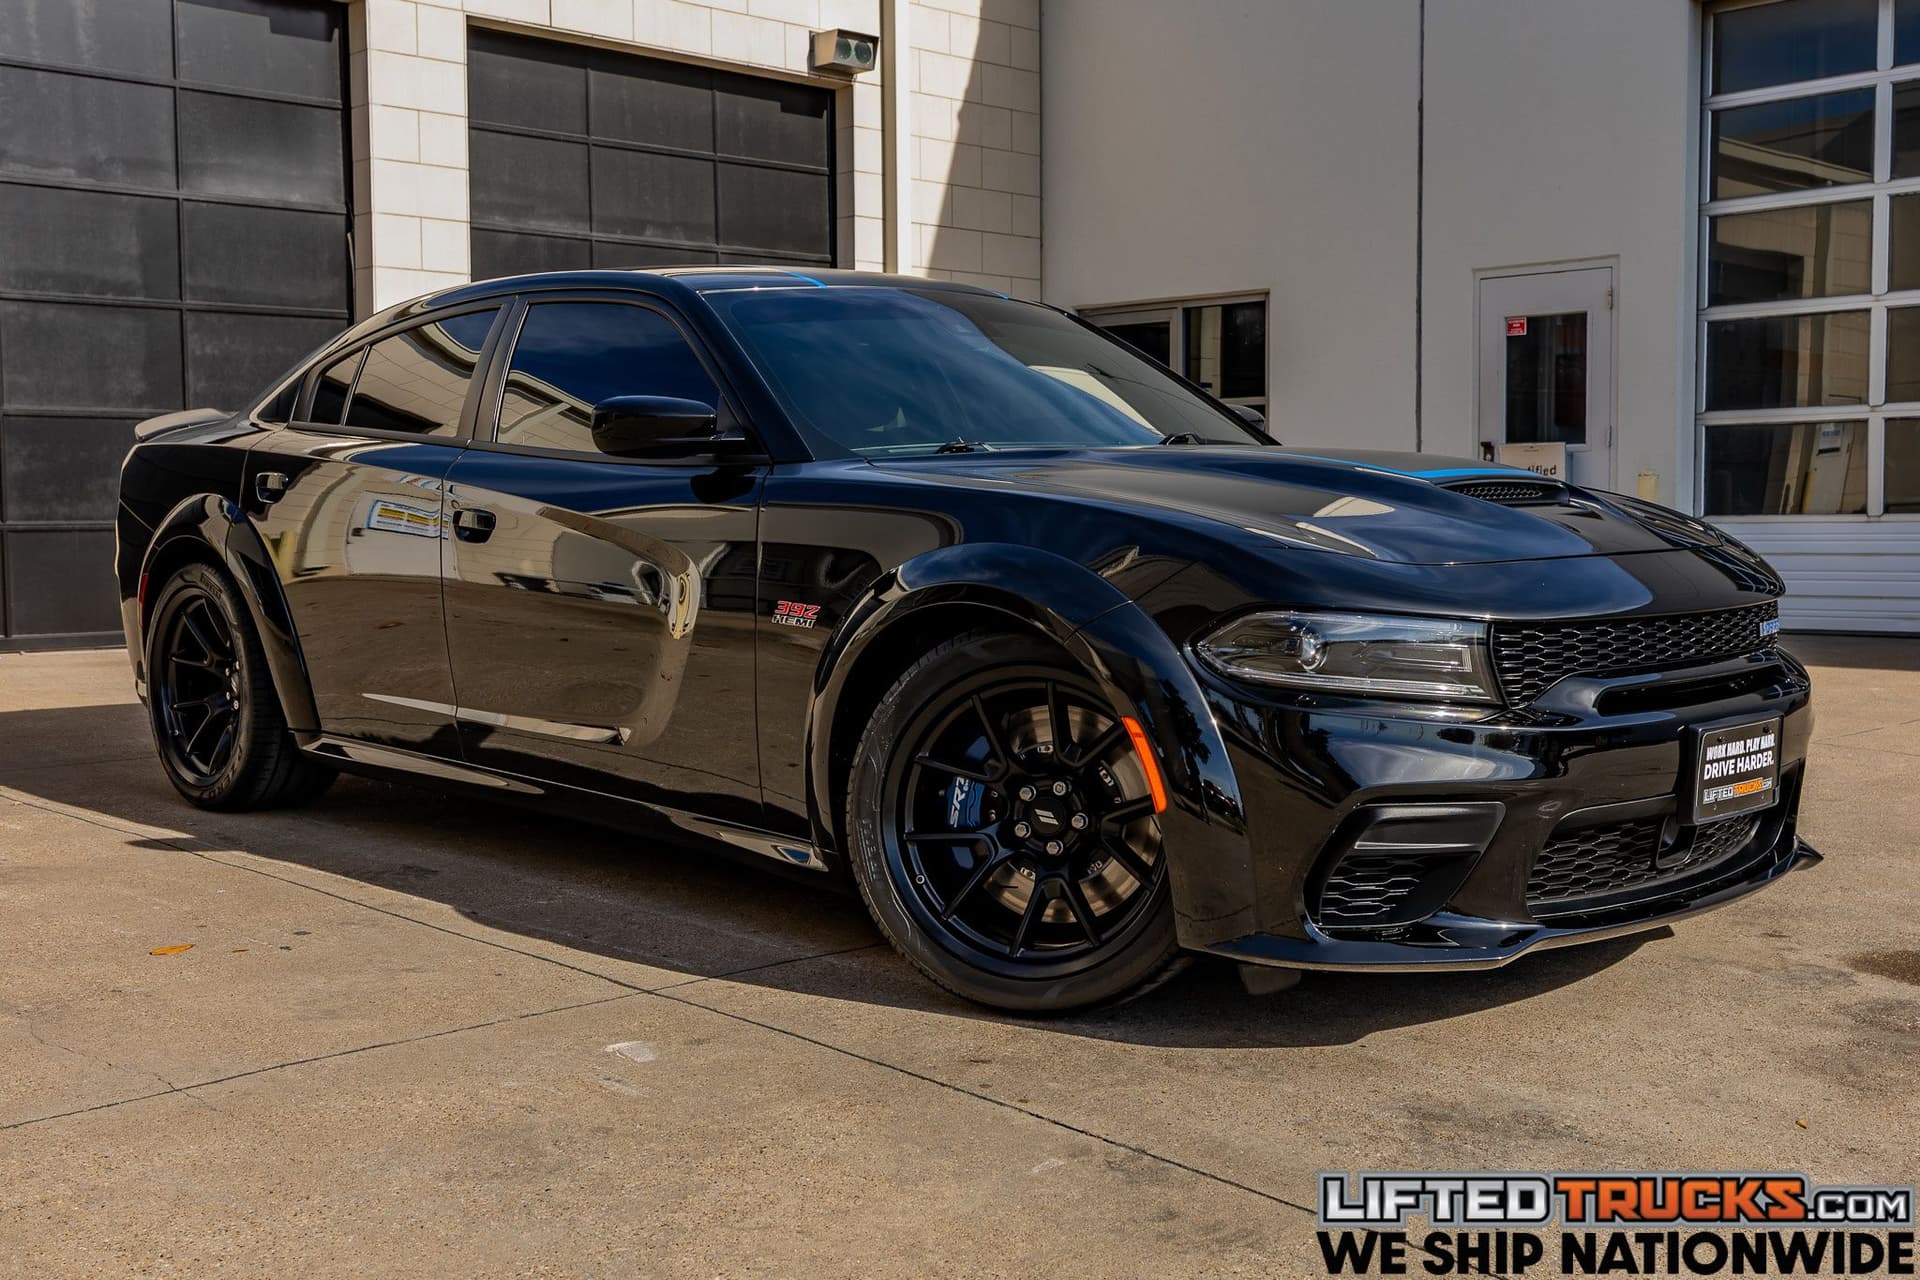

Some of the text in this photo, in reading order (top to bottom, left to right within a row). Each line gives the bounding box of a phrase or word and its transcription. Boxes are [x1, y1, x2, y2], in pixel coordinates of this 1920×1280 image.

[775, 600, 821, 619] 392
[772, 614, 816, 628] HEMI
[1706, 744, 1727, 761] WORK
[1727, 740, 1745, 757] HARD.
[1746, 737, 1760, 753] PLAY
[1704, 751, 1774, 780] DRIVE HARDER.
